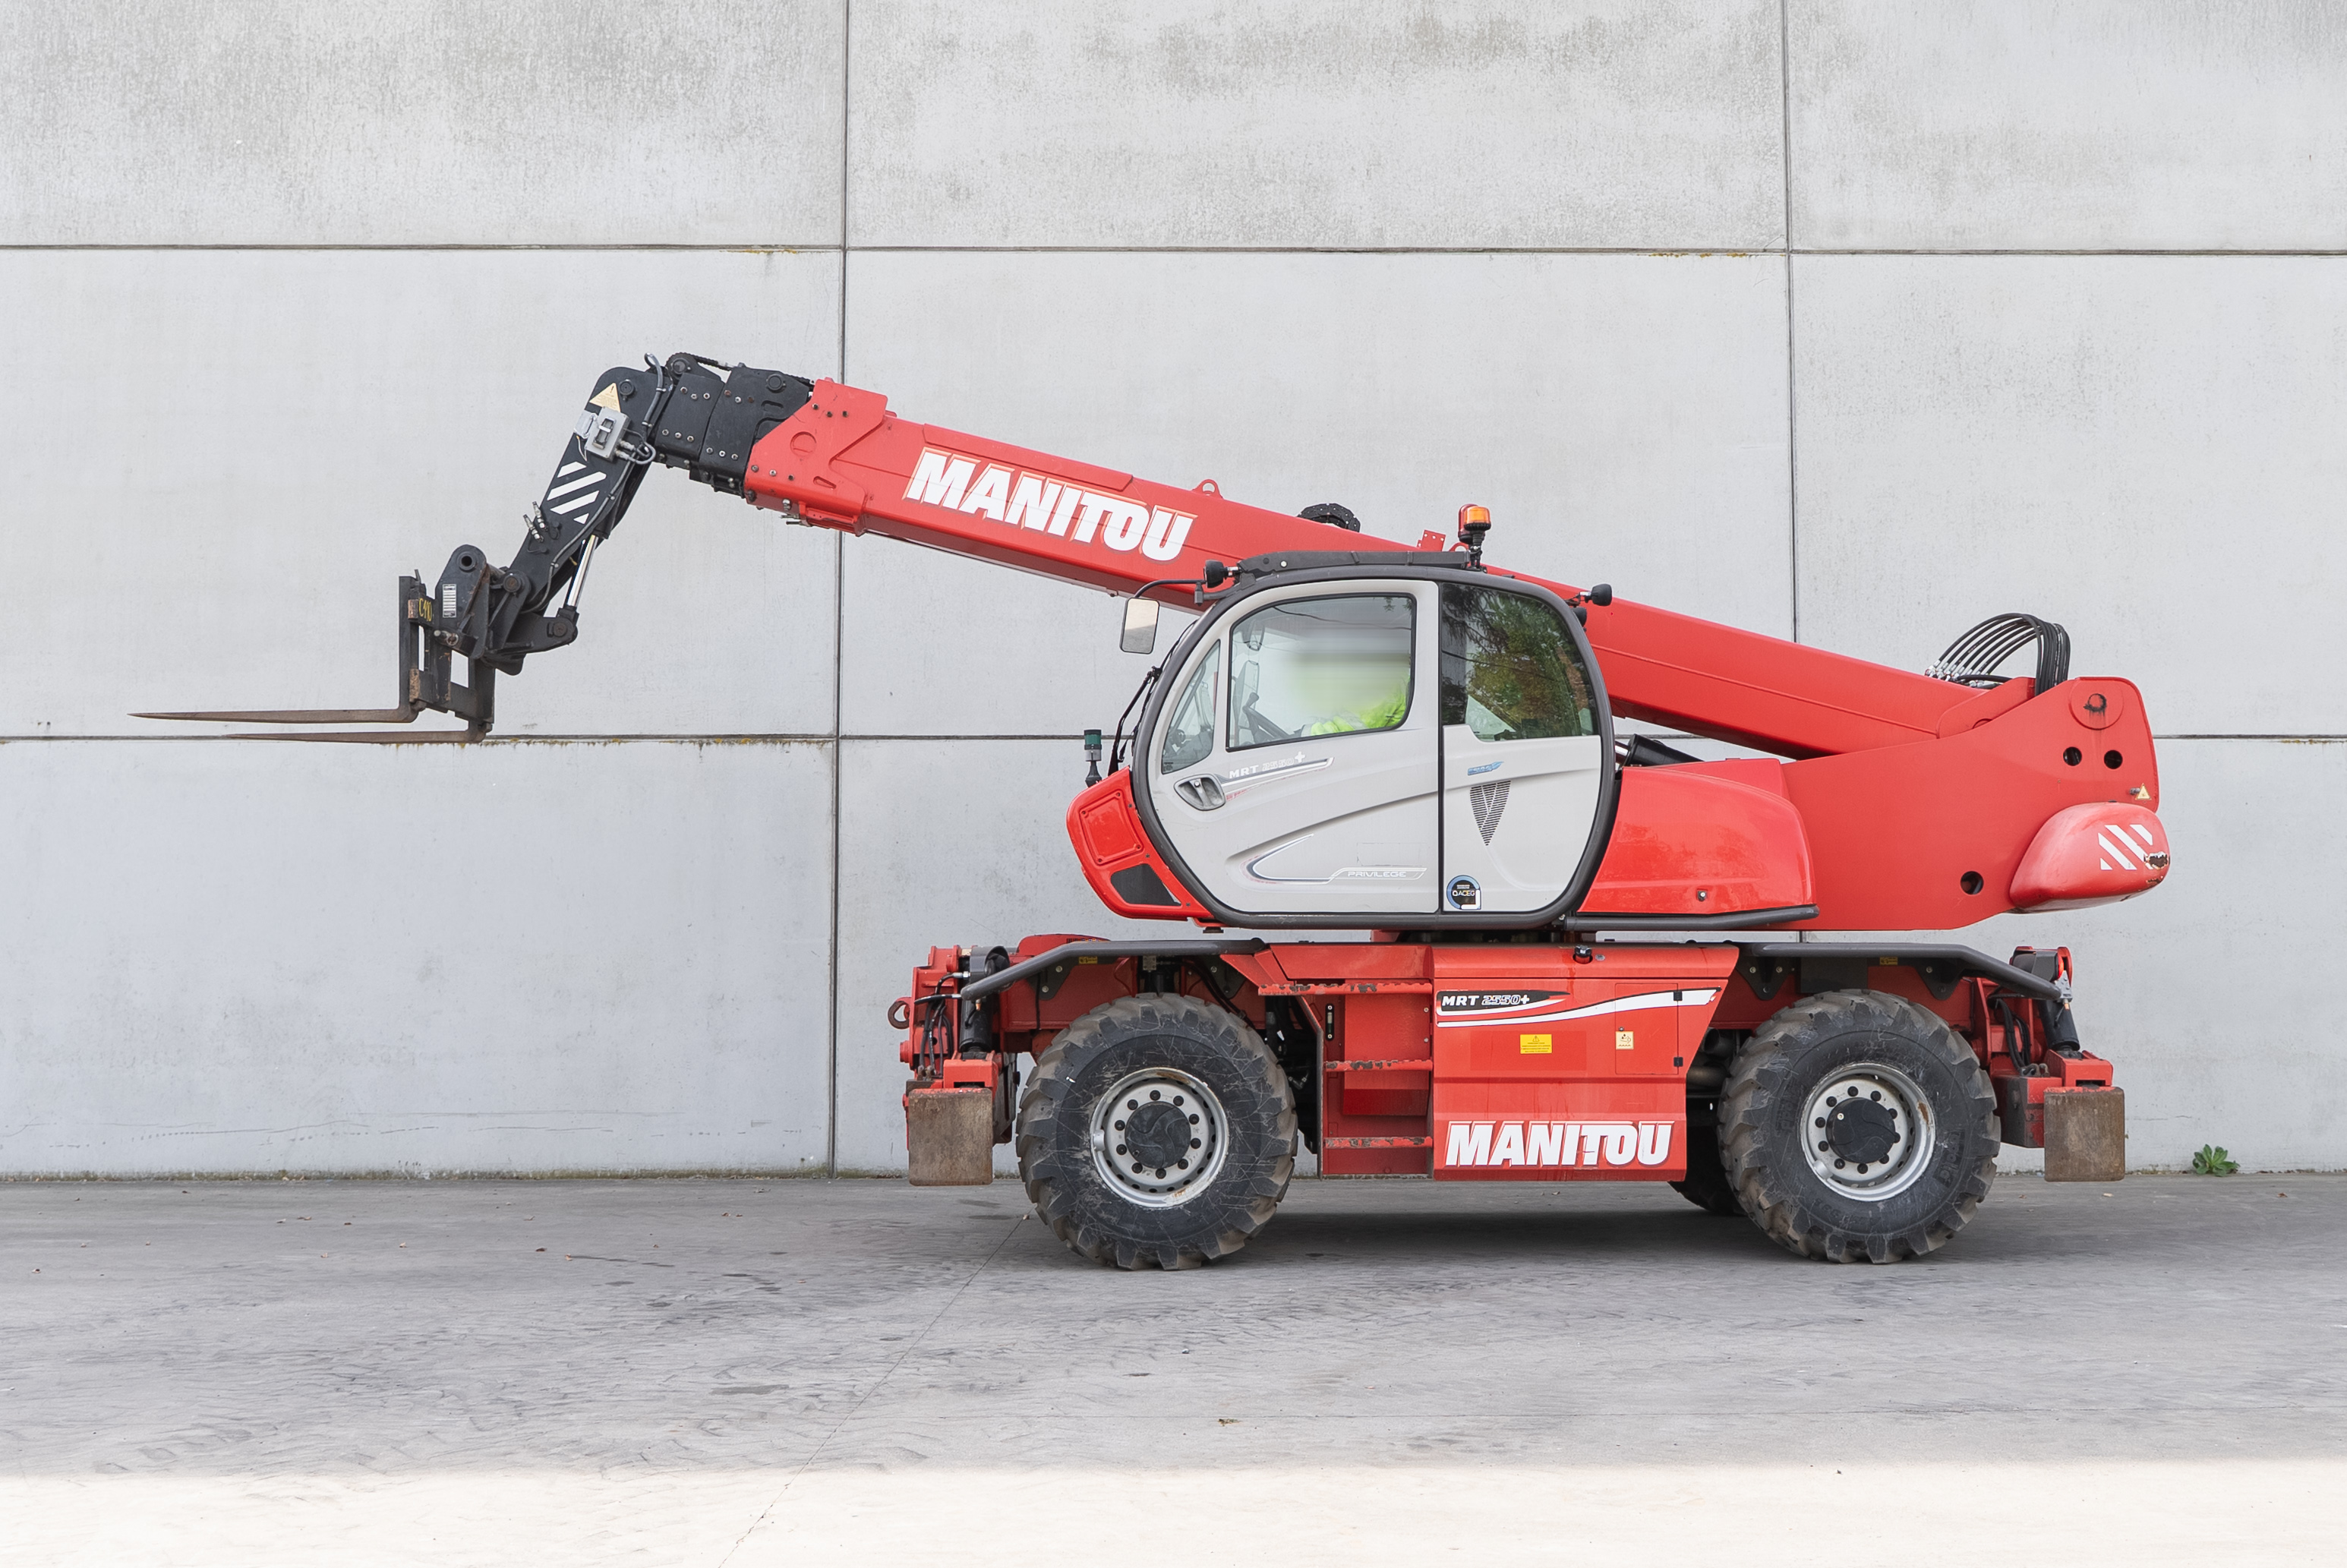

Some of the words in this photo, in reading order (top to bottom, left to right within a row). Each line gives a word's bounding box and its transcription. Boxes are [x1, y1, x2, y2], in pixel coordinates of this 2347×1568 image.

[902, 447, 1197, 563] MANITOU
[1229, 764, 1259, 779] MRT
[1441, 995, 1480, 1006] MRT
[1444, 1121, 1674, 1167] MANITOU
